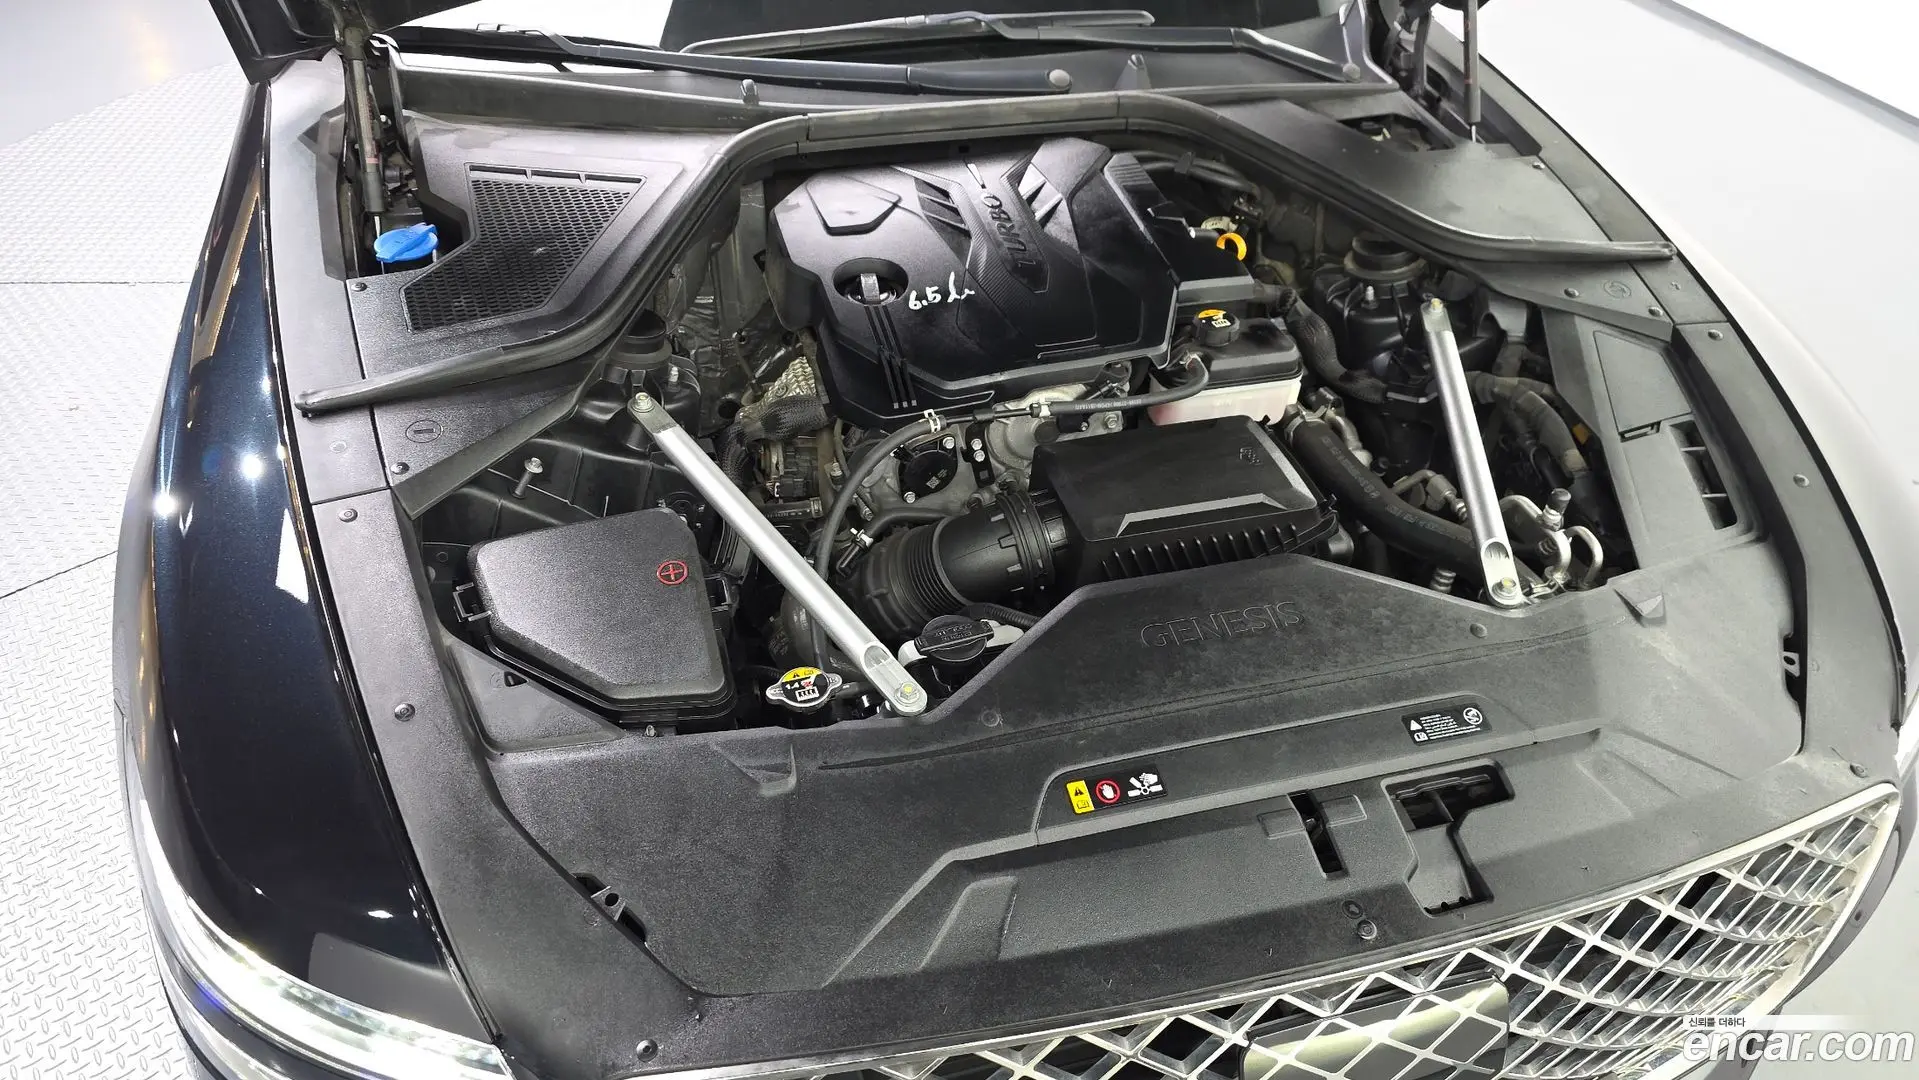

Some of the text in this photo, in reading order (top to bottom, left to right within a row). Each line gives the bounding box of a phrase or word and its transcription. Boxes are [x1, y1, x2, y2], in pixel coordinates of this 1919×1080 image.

[981, 194, 1037, 268] TURBO
[908, 285, 942, 311] 6.5
[1140, 601, 1305, 648] GENESIS
